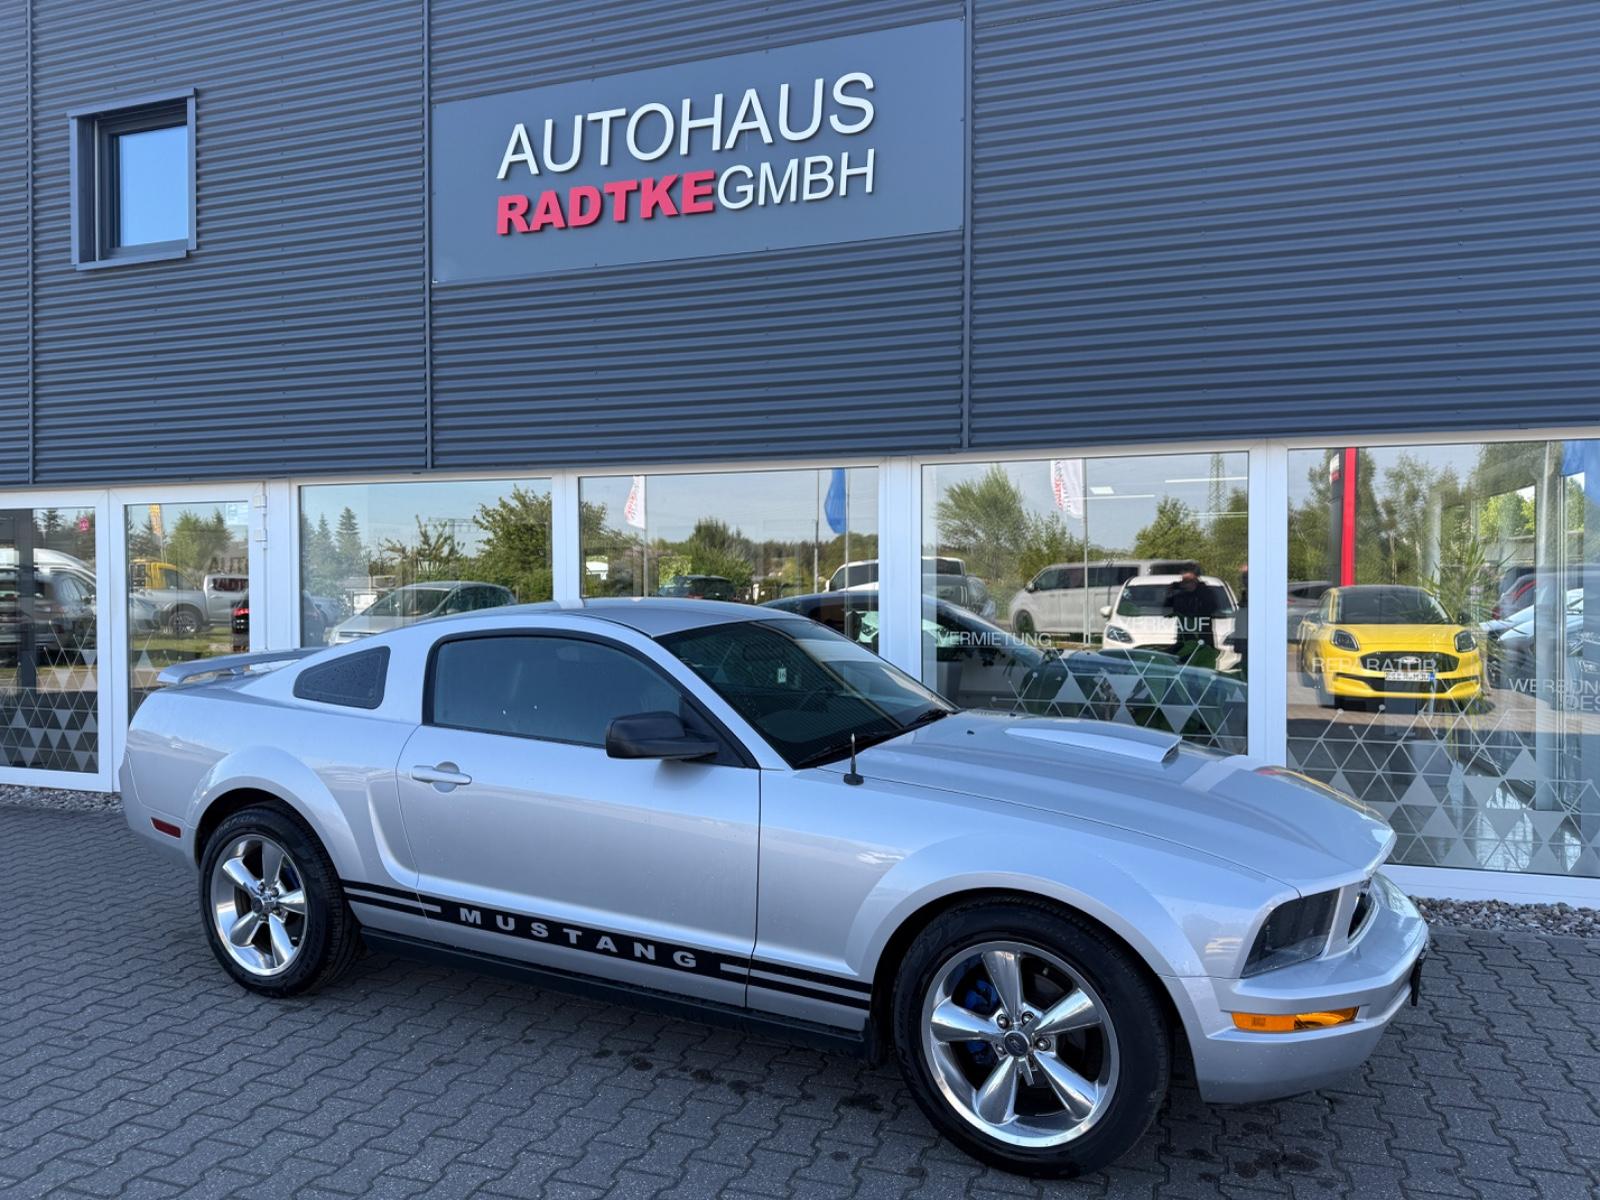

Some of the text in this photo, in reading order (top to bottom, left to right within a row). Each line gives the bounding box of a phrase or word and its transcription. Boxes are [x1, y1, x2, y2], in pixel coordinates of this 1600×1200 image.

[497, 72, 876, 179] AUTOHAUS
[937, 630, 1052, 647] VERMIETUNG
[1311, 656, 1437, 673] REPARATUR
[1508, 678, 1600, 695] WERBUN
[459, 906, 698, 969] MUSTANG
